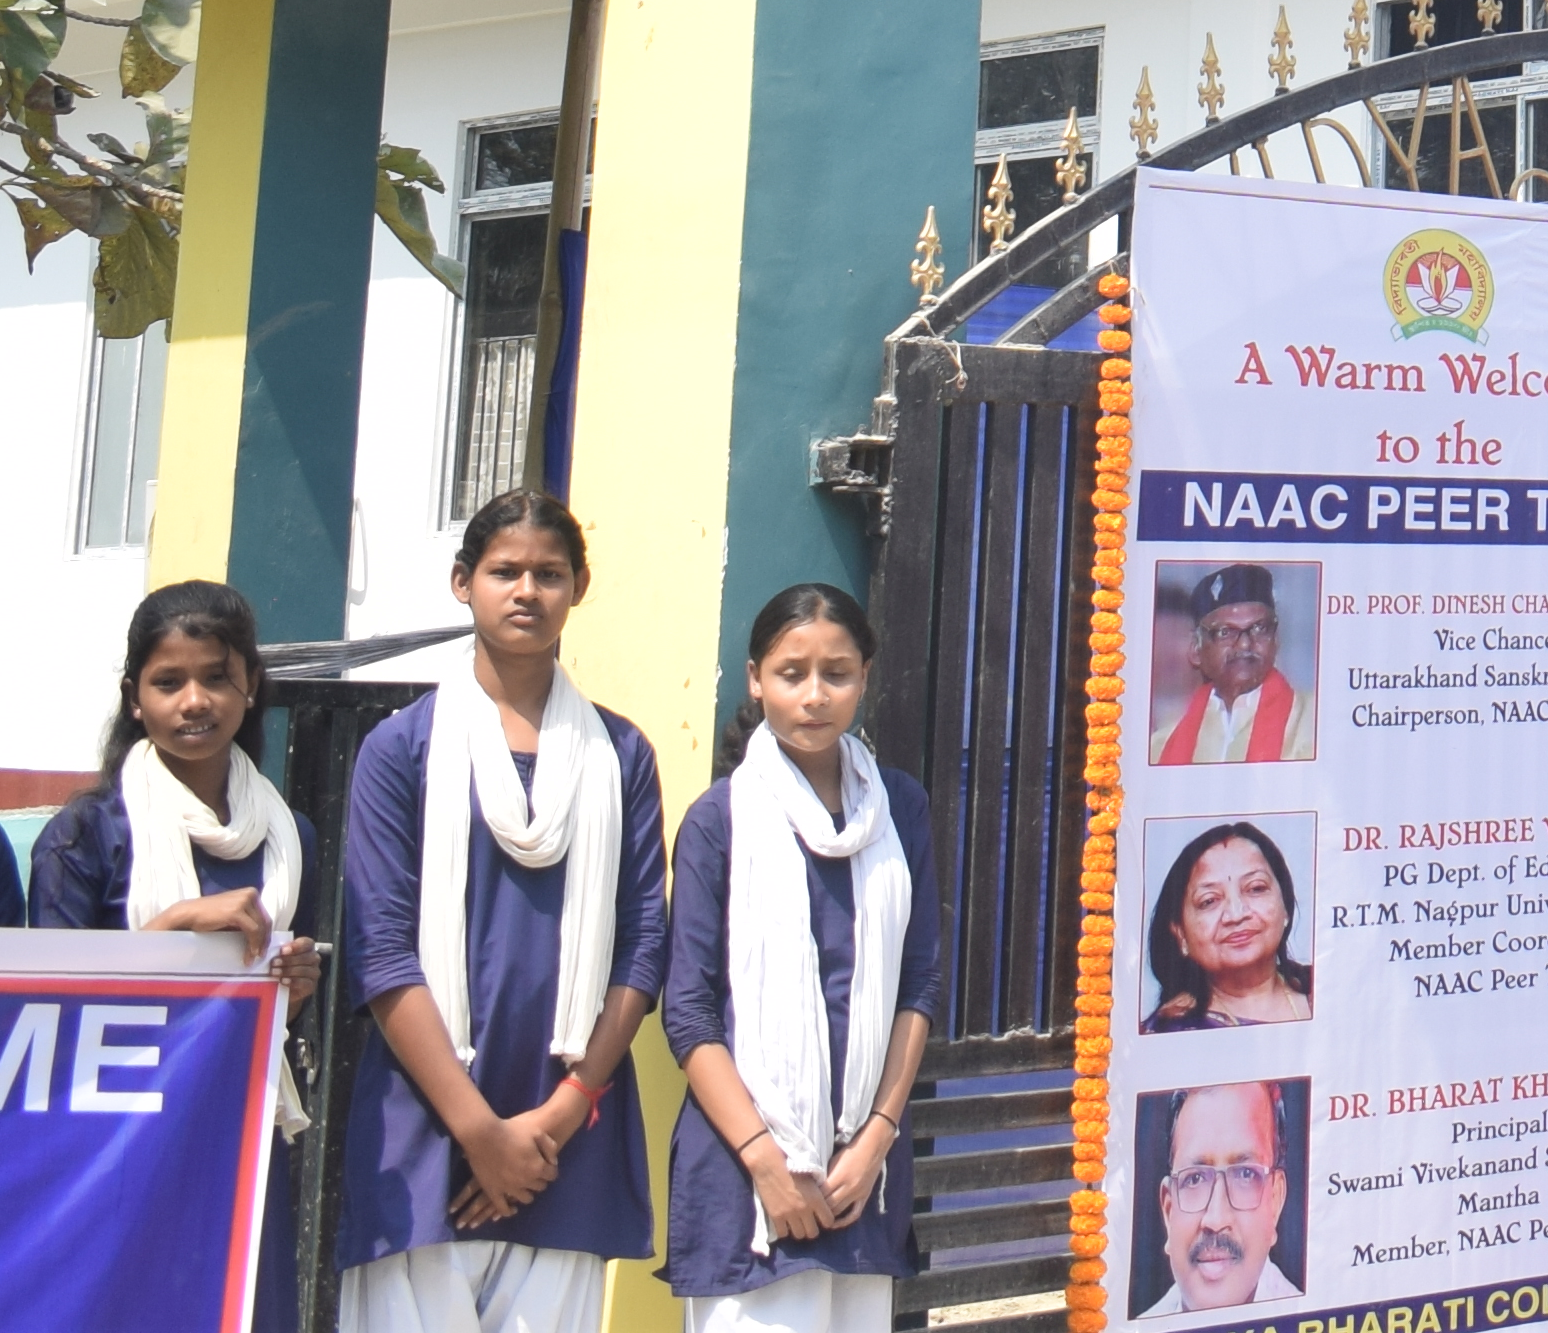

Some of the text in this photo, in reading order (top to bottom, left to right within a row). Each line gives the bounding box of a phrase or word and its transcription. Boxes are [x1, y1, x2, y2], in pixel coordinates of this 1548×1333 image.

[1234, 341, 1273, 386] A
[1285, 344, 1427, 393] Warm
[1376, 419, 1503, 466] to the
[1183, 482, 1349, 530] NAAC
[1367, 485, 1511, 531] PEER
[1326, 594, 1360, 616] DR.
[1366, 594, 1425, 616] PROF.
[1432, 594, 1506, 615] DINESH
[1432, 628, 1476, 652] Vice
[1348, 663, 1478, 691] Uttarakhand
[1352, 702, 1485, 732] Chairperson,
[1342, 826, 1389, 852] DR.
[1399, 817, 1535, 851] RAJSHREE
[1384, 863, 1419, 887] PG
[1427, 861, 1486, 889] Dept.
[1493, 855, 1519, 885] of
[1331, 902, 1406, 928] R.T.M.
[1413, 899, 1499, 927] Nagpur
[1388, 933, 1485, 962] Member
[1414, 970, 1483, 998] NAAC
[1490, 967, 1538, 992] Peer
[1328, 1093, 1377, 1122] DR.
[1386, 1077, 1504, 1116] BHARAT
[1451, 1109, 1548, 1144] Principal
[1327, 1167, 1403, 1196] Swami
[1410, 1146, 1538, 1185] Vivekanand
[1457, 1183, 1540, 1216] Mantha
[1351, 1234, 1450, 1267] Member,
[1457, 1222, 1522, 1252] NAAC
